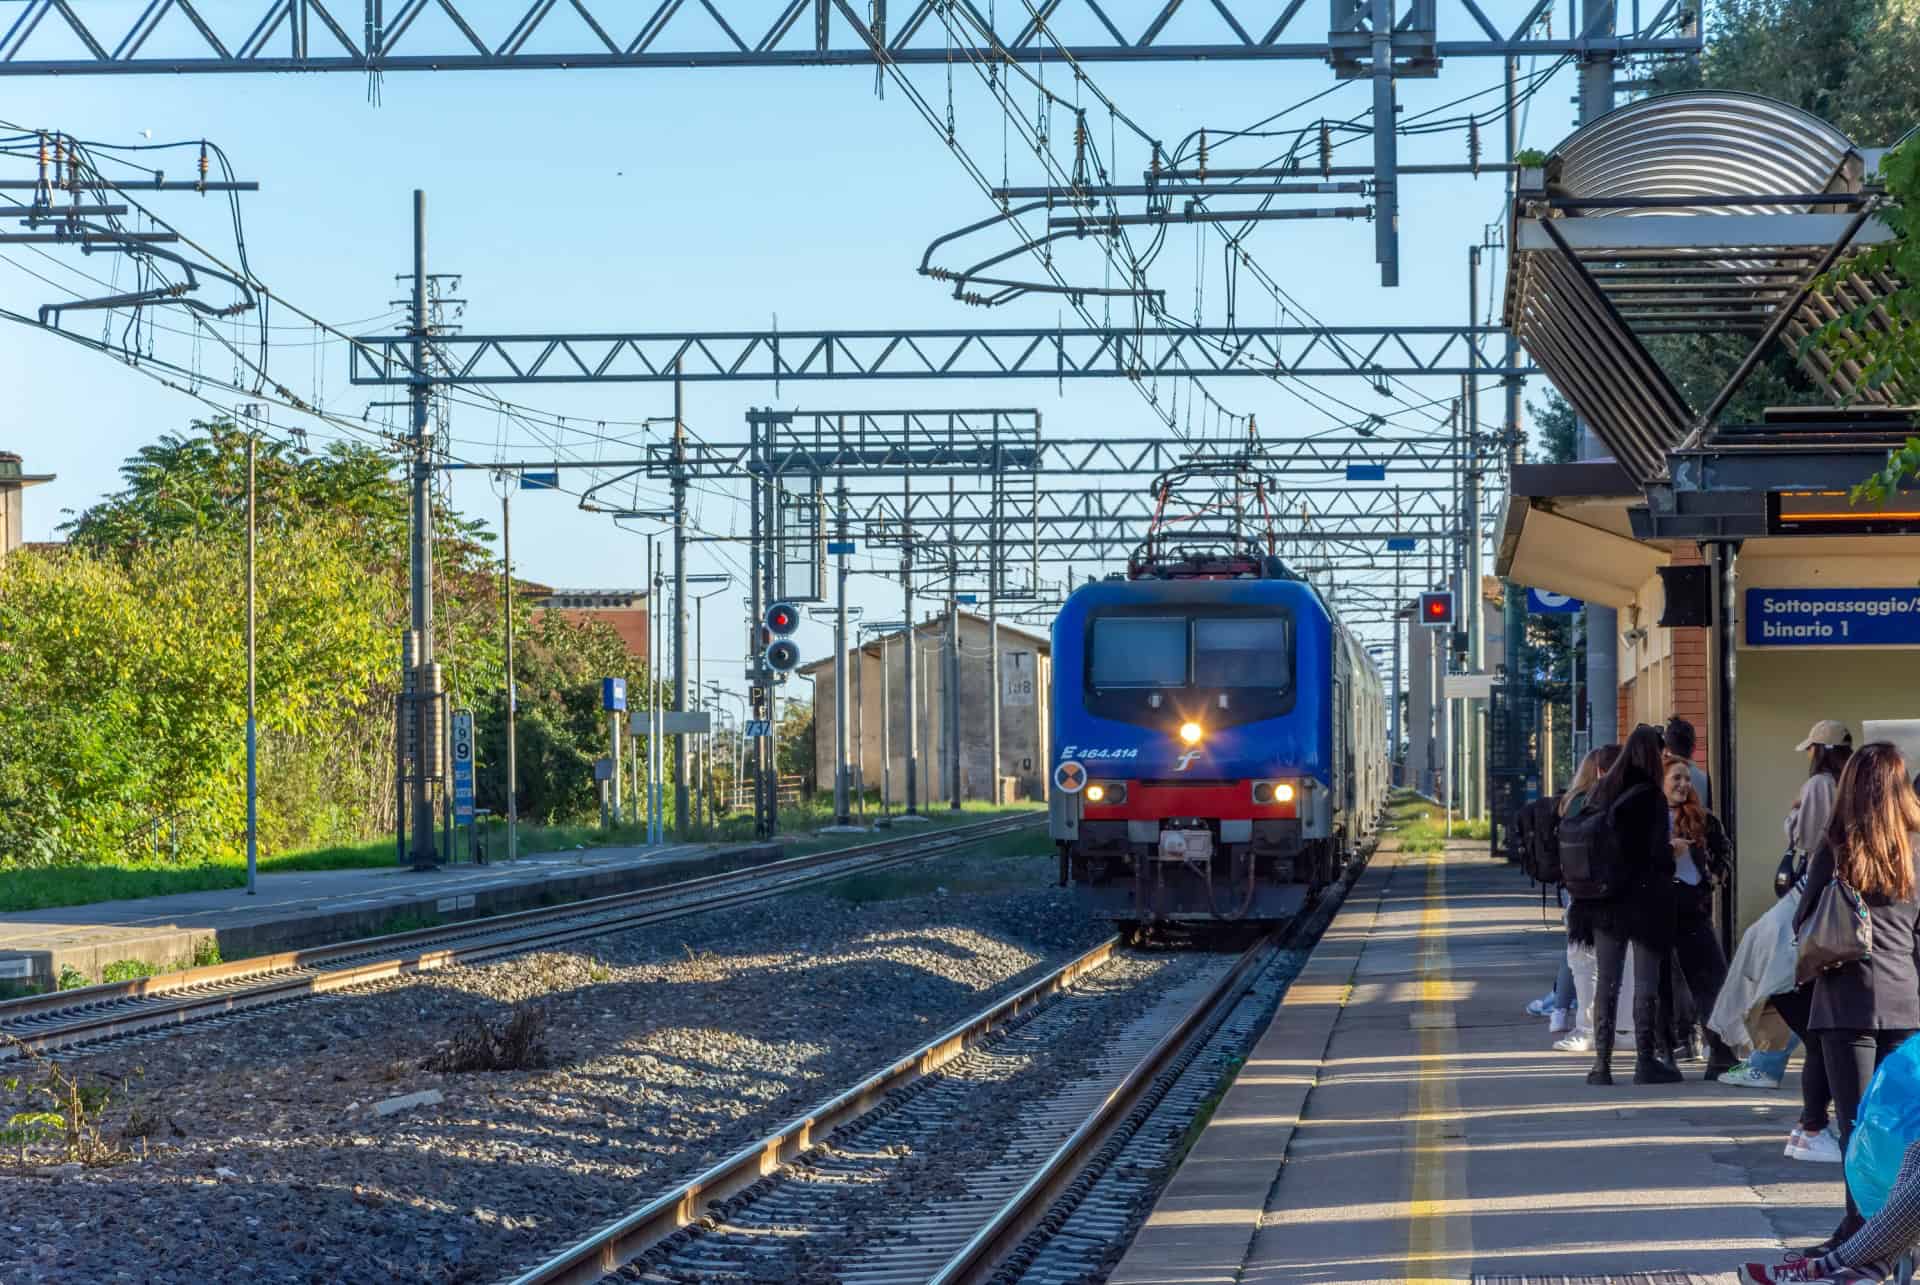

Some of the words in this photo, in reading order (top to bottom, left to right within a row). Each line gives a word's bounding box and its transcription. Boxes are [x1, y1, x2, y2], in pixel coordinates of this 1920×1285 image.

[1763, 620, 1833, 637] binario
[1840, 620, 1849, 637] 1
[1060, 745, 1078, 760] E
[1077, 748, 1138, 759] 464.414
